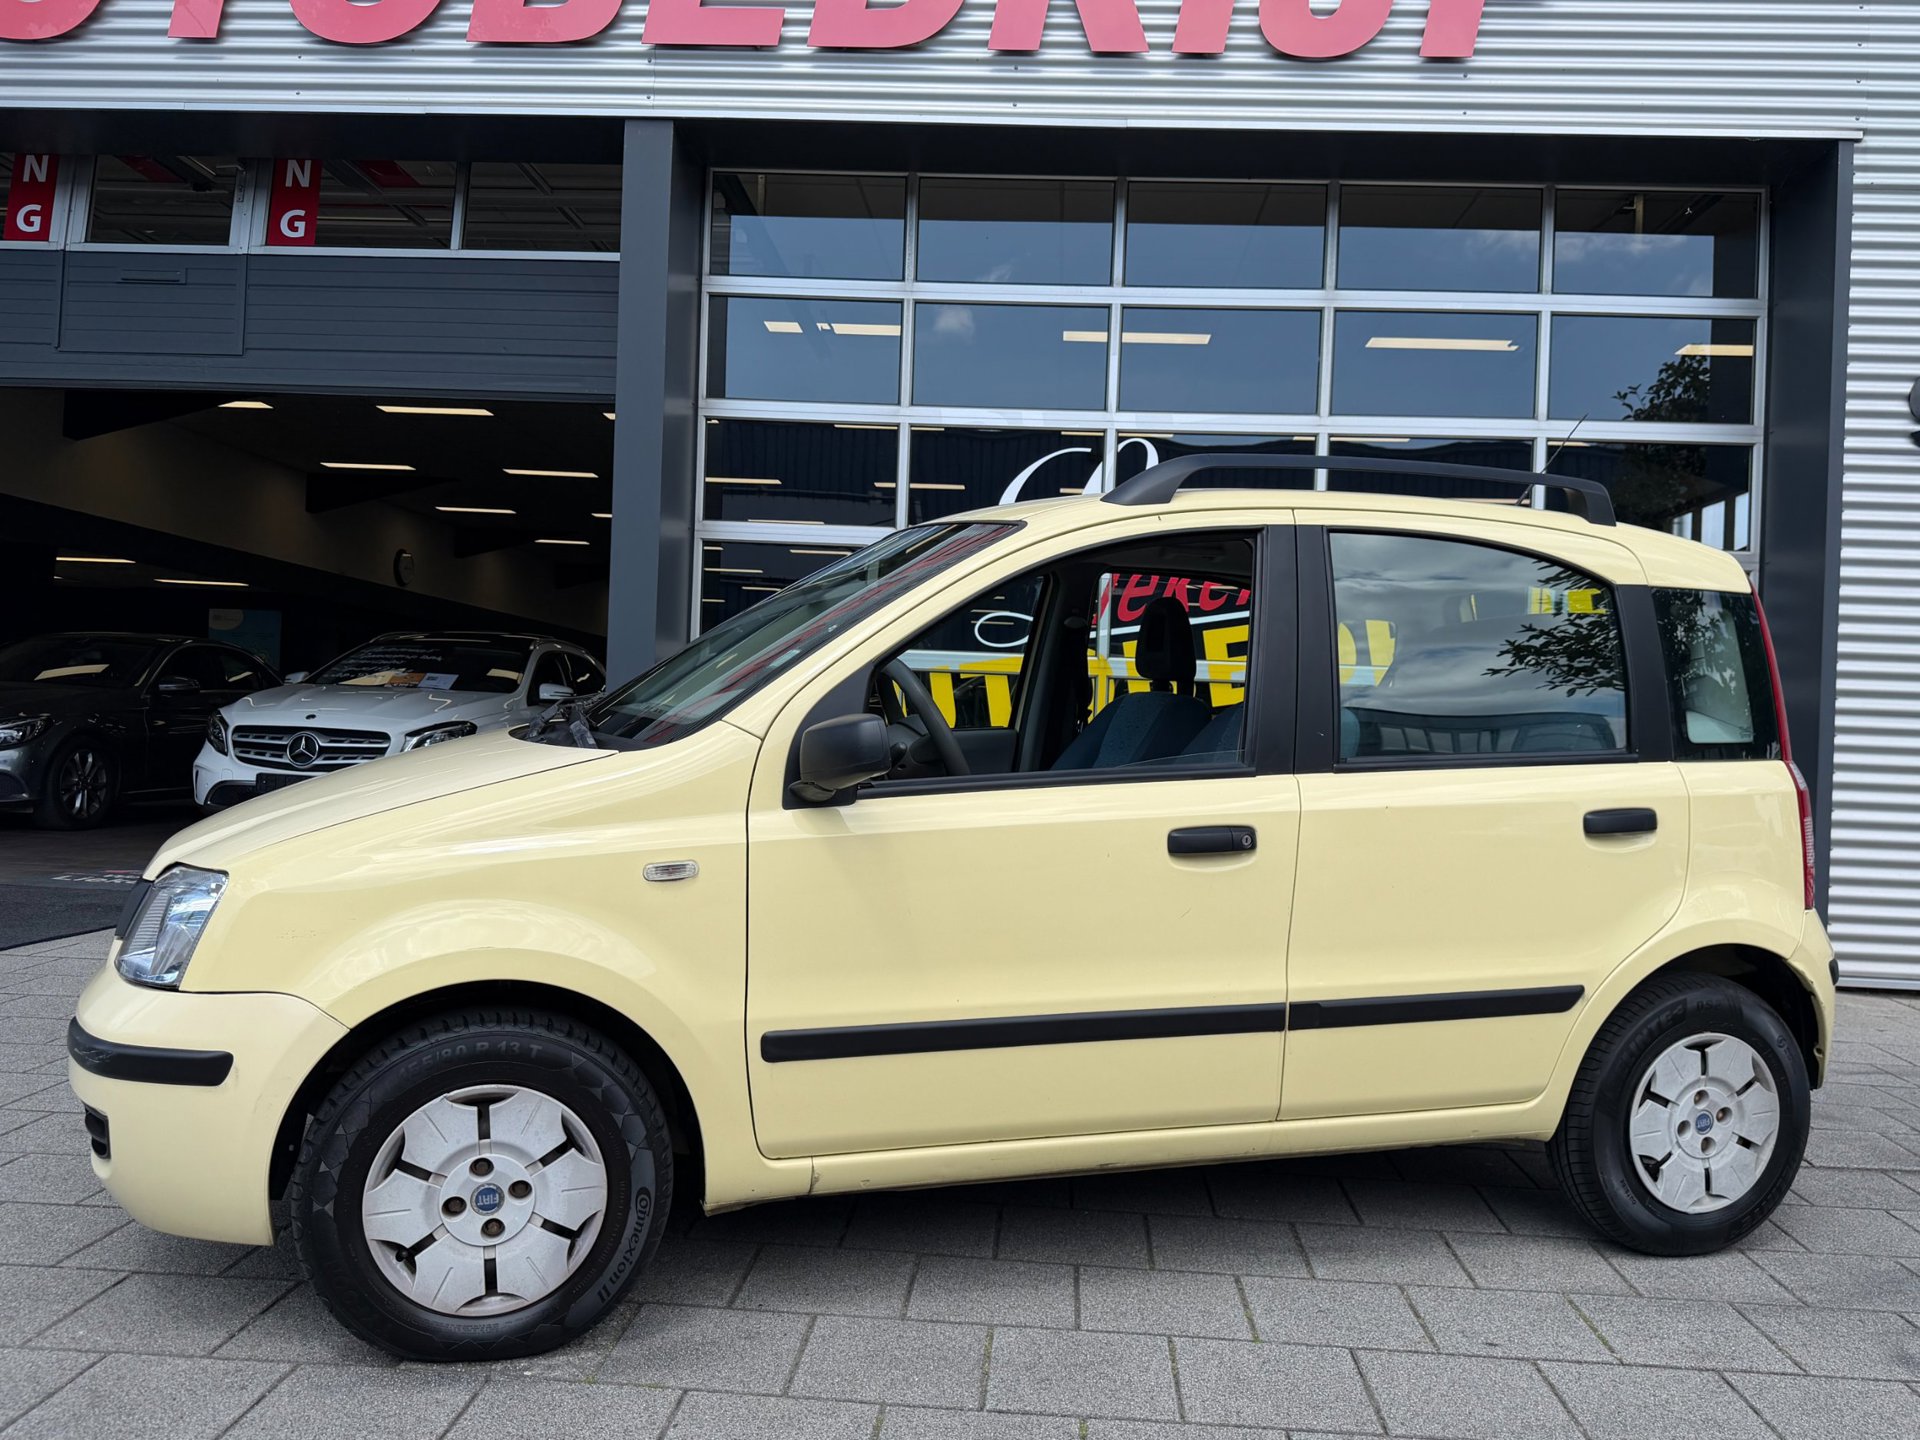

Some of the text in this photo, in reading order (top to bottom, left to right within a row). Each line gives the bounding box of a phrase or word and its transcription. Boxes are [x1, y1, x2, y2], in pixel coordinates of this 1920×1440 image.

[496, 1039, 521, 1057] 13
[528, 1042, 544, 1060] T
[476, 1193, 500, 1206] FIAT
[608, 1186, 653, 1286] Connexion
